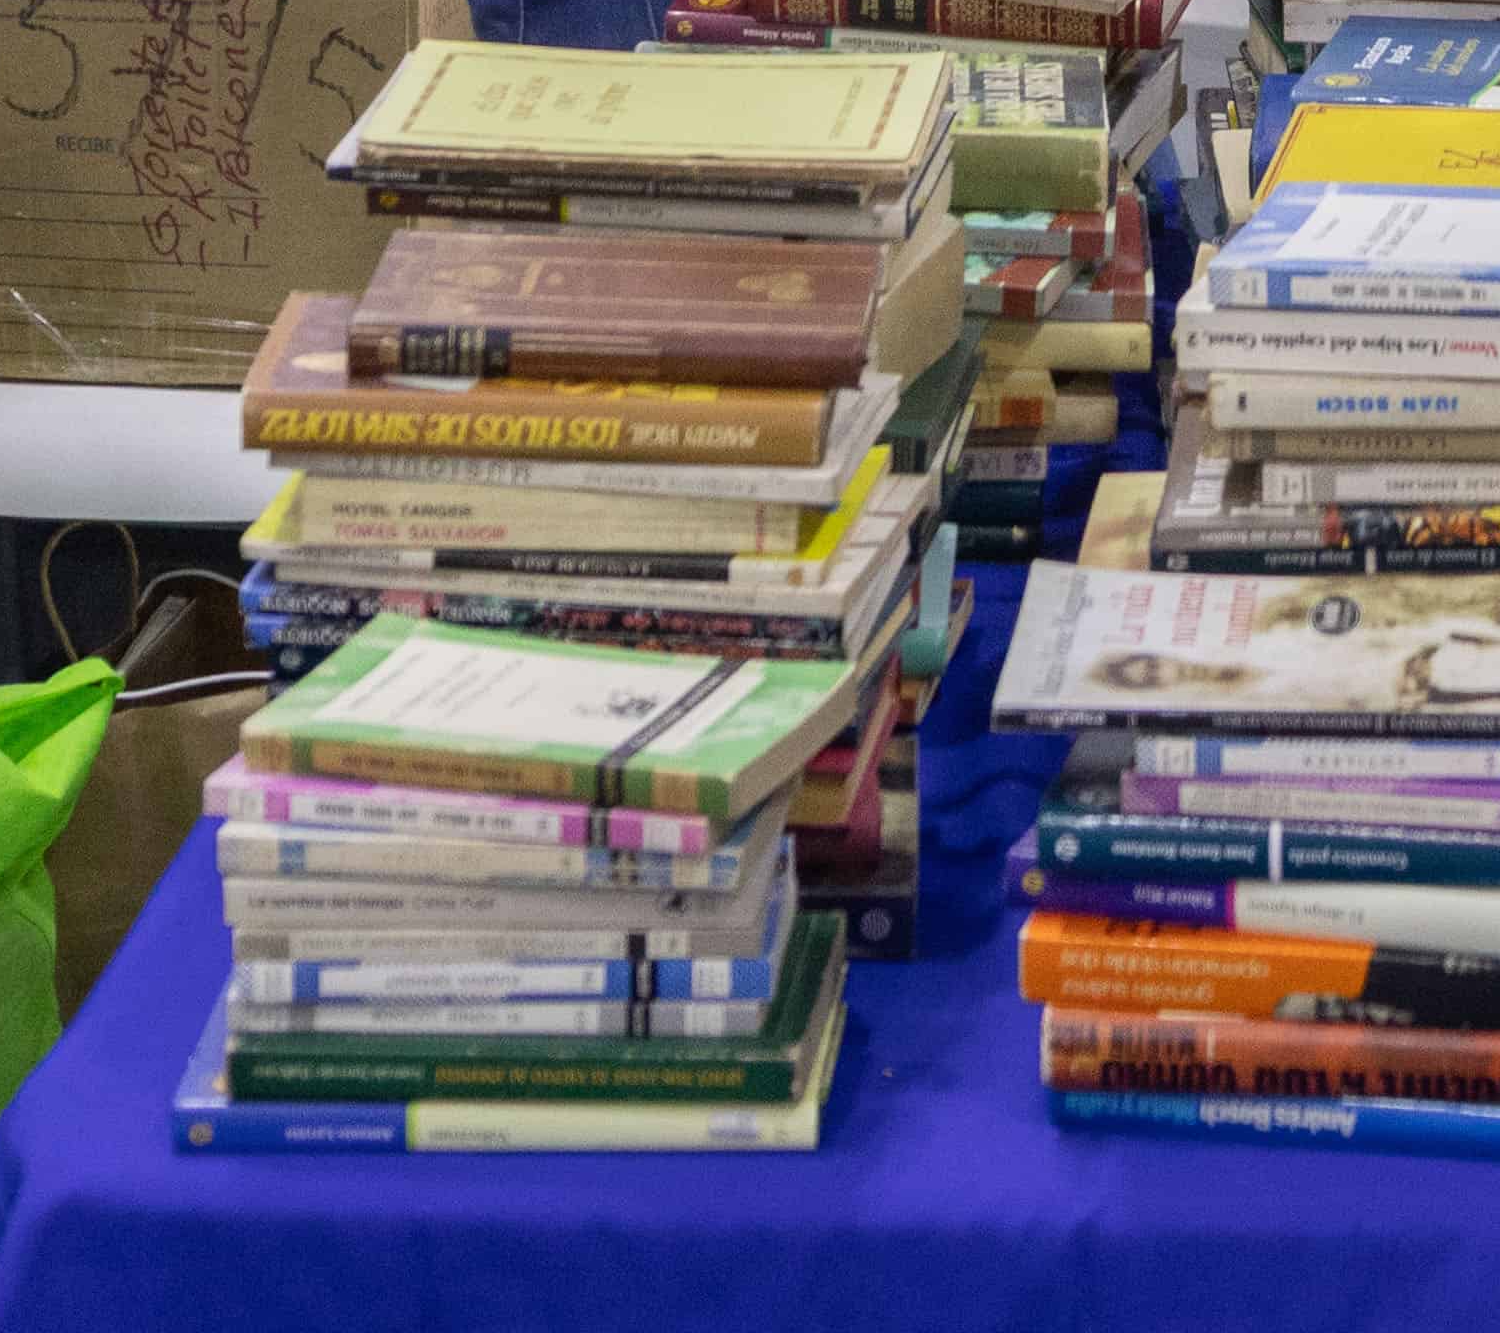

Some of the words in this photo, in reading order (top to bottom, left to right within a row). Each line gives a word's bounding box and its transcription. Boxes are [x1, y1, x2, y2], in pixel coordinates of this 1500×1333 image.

[1329, 335, 1359, 353] del
[1361, 332, 1403, 354] hijos
[1450, 339, 1499, 358] Verne
[1315, 396, 1391, 413] BOSCH
[1401, 396, 1460, 413] JUAN
[1200, 1100, 1270, 1133] Bosch
[1274, 1104, 1357, 1139] Andrés
